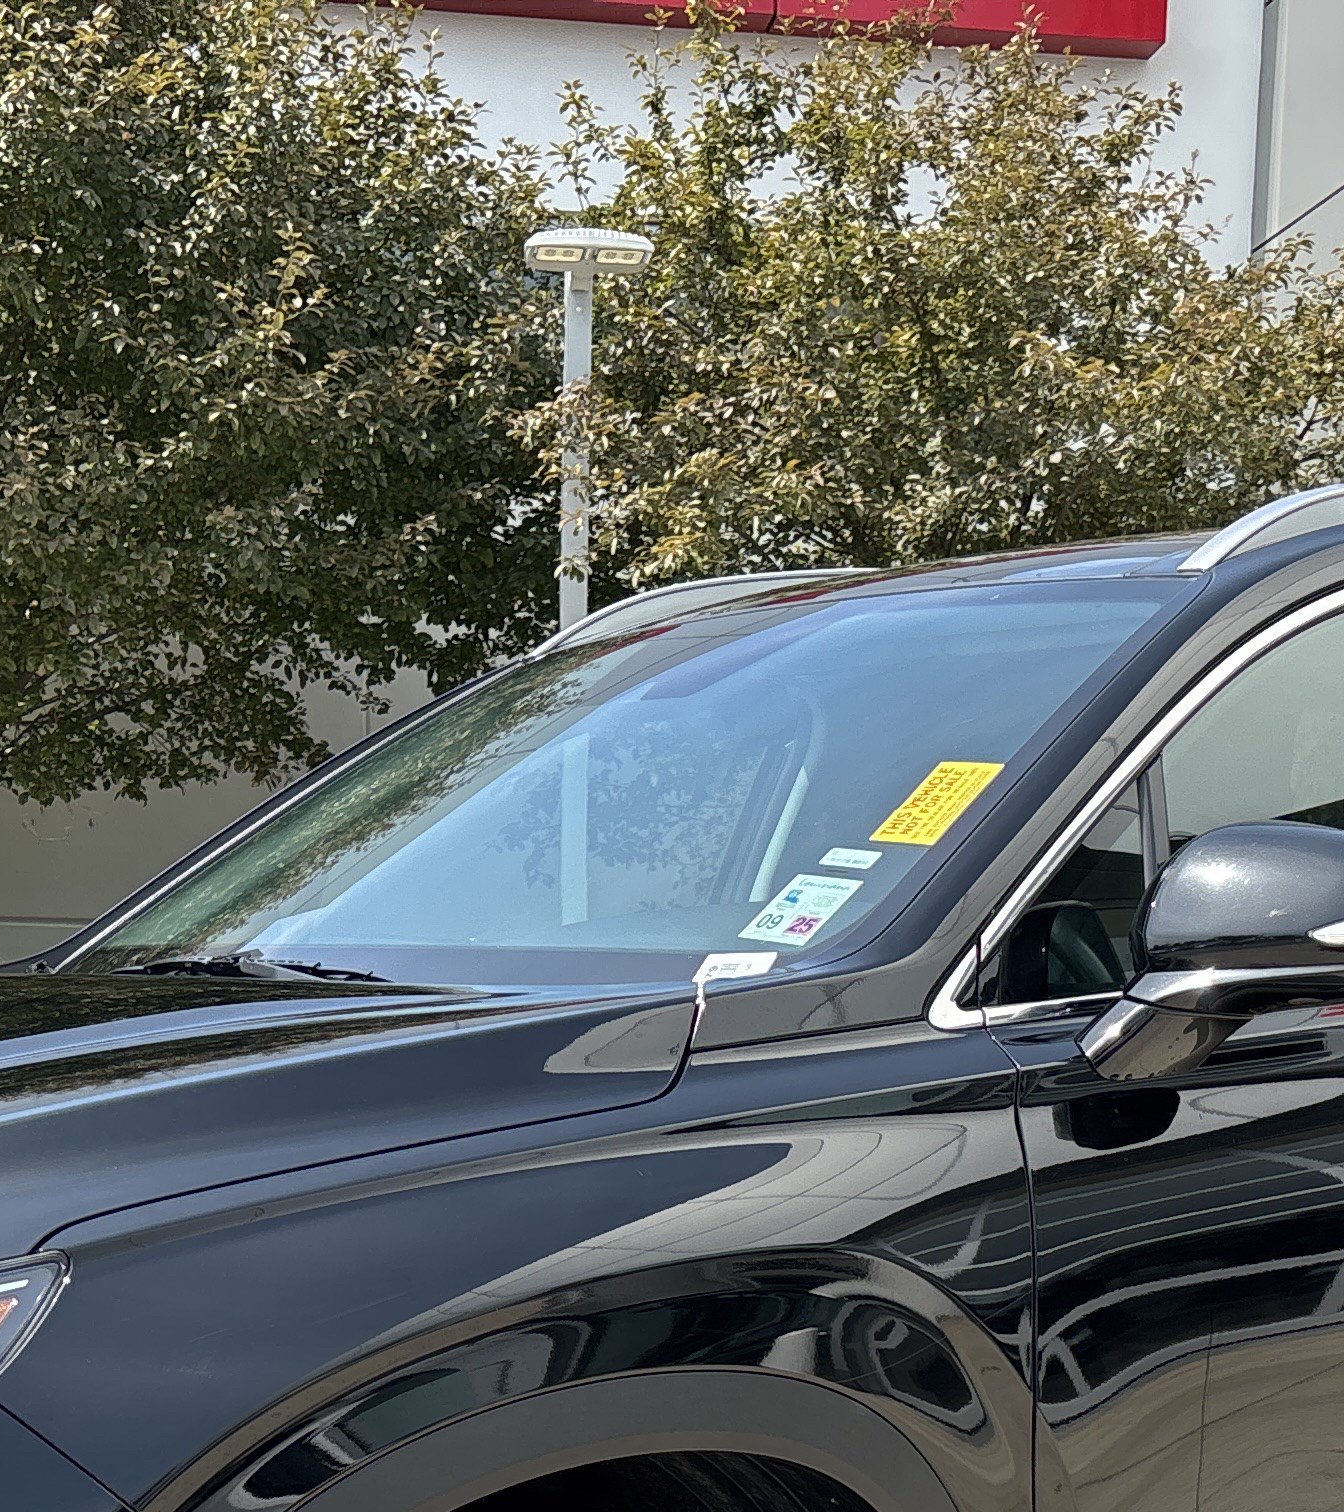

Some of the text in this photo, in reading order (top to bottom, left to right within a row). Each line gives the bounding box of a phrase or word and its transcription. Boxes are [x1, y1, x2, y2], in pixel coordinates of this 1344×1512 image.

[879, 811, 913, 836] THIS
[902, 767, 955, 810] VEHICLE
[899, 770, 968, 835] NOT FOR SALE
[755, 913, 820, 935] 09 25
